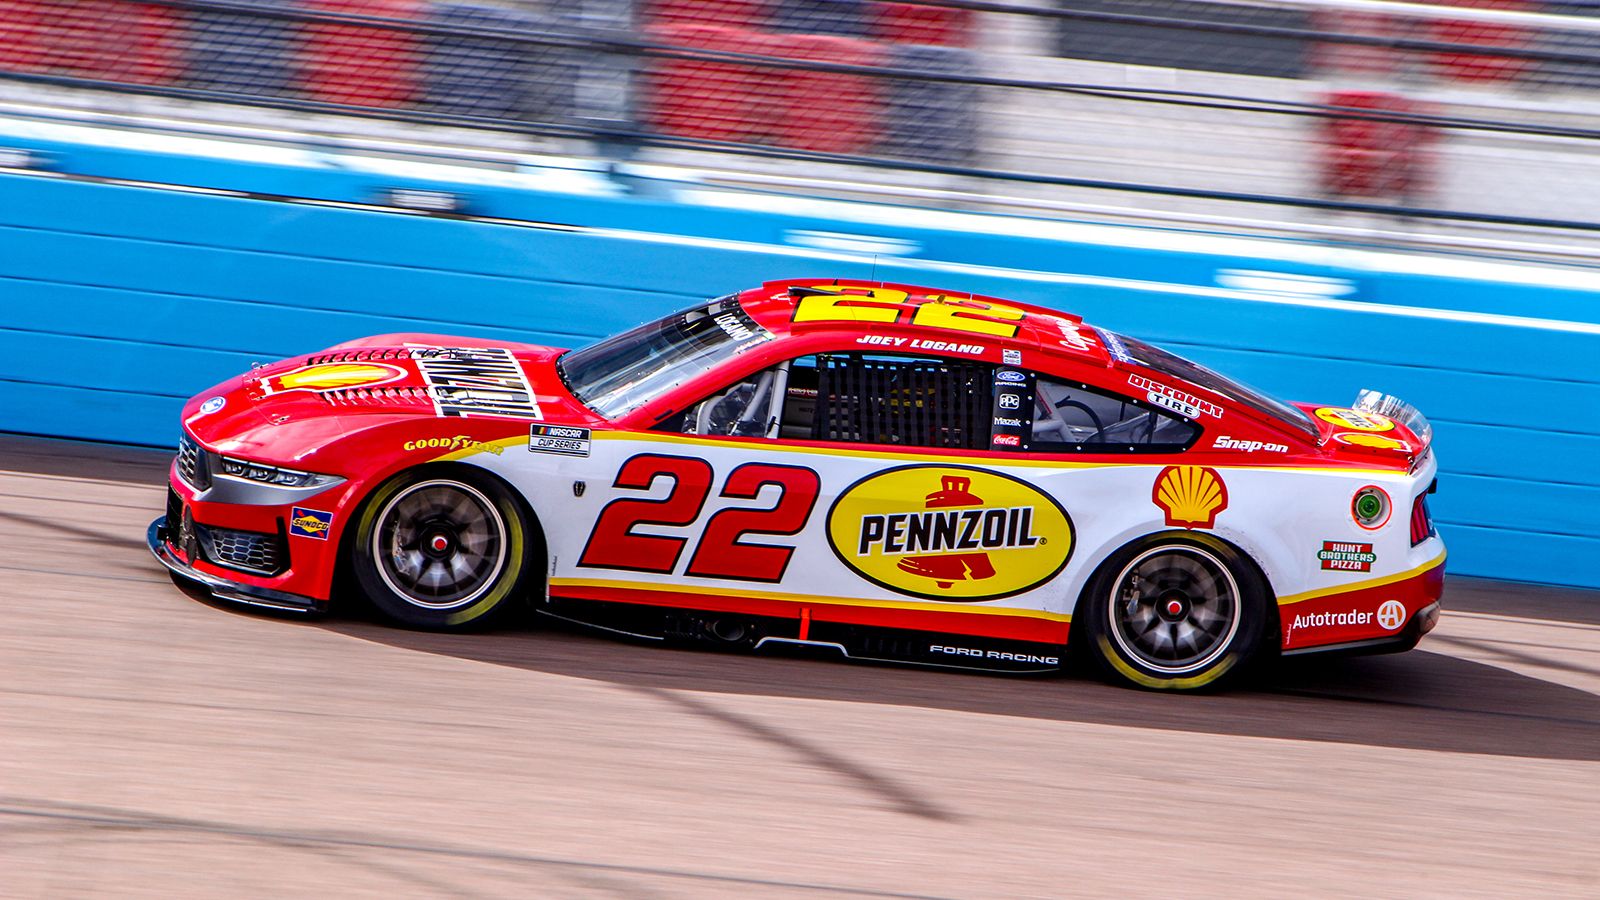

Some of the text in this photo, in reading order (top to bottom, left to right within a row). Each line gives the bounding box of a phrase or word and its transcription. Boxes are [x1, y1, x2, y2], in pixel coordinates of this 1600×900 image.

[790, 285, 1028, 338] 22
[714, 312, 754, 341] LOGANO
[856, 335, 985, 355] JOEY LOGANO
[1000, 396, 1019, 407] PPG
[1129, 374, 1223, 418] DISCOUNT
[1154, 393, 1193, 415] TIRE
[994, 417, 1021, 427] Mazak
[550, 427, 582, 438] NASCAR
[537, 438, 582, 449] CUP SERIES
[1212, 436, 1289, 452] Snap-on
[294, 518, 329, 530] SUNOCO
[577, 453, 821, 584] 22
[858, 507, 1040, 556] PENNZOIL
[1320, 551, 1375, 562] BROTHERS
[1332, 543, 1363, 553] HUNT
[1330, 560, 1362, 570] PIZZA
[1292, 609, 1374, 629] Autotrader
[930, 645, 1059, 665] FORD RACING
